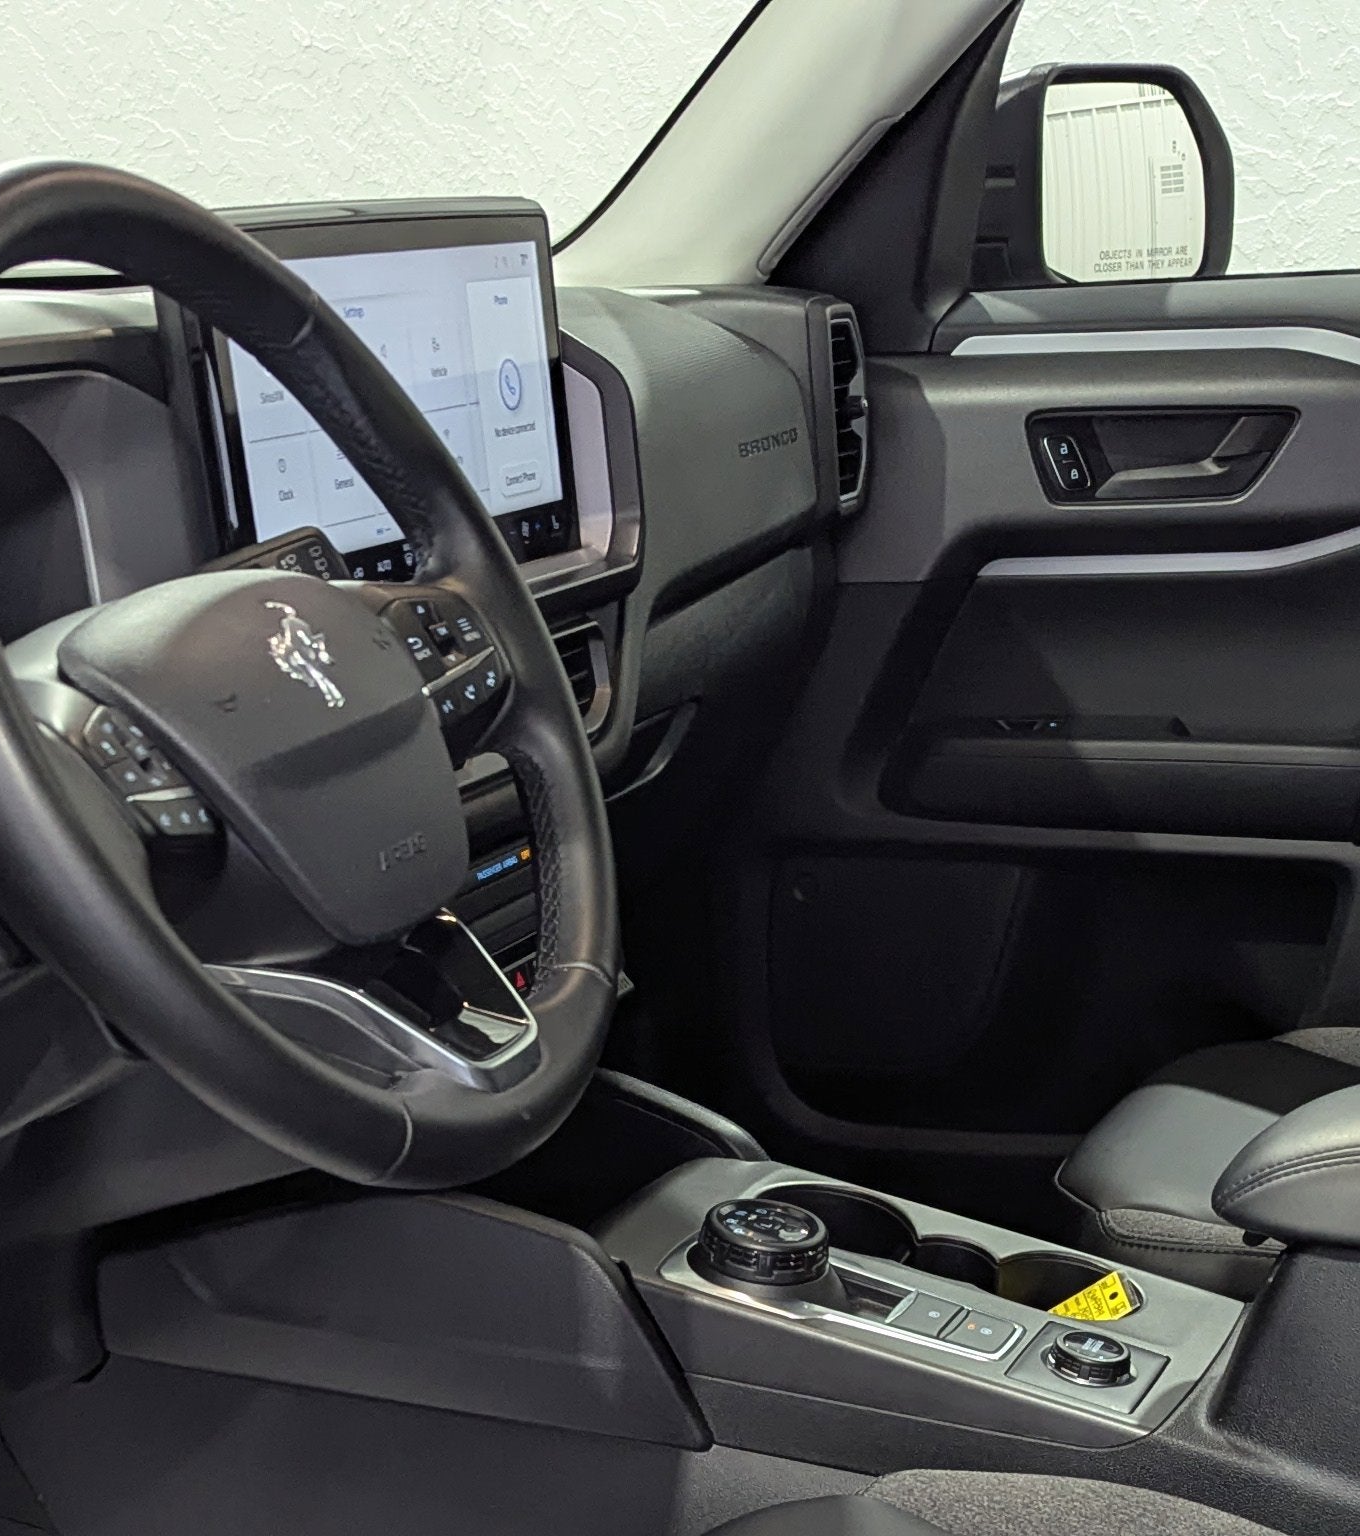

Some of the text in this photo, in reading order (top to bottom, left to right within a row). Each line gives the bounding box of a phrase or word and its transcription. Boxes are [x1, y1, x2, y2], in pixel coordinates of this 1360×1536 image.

[1099, 245, 1188, 261] OBJECTS IN MIRROR ARE
[1094, 257, 1193, 274] CLOSER THAN THEY APPEAR
[738, 427, 799, 458] BRONCO
